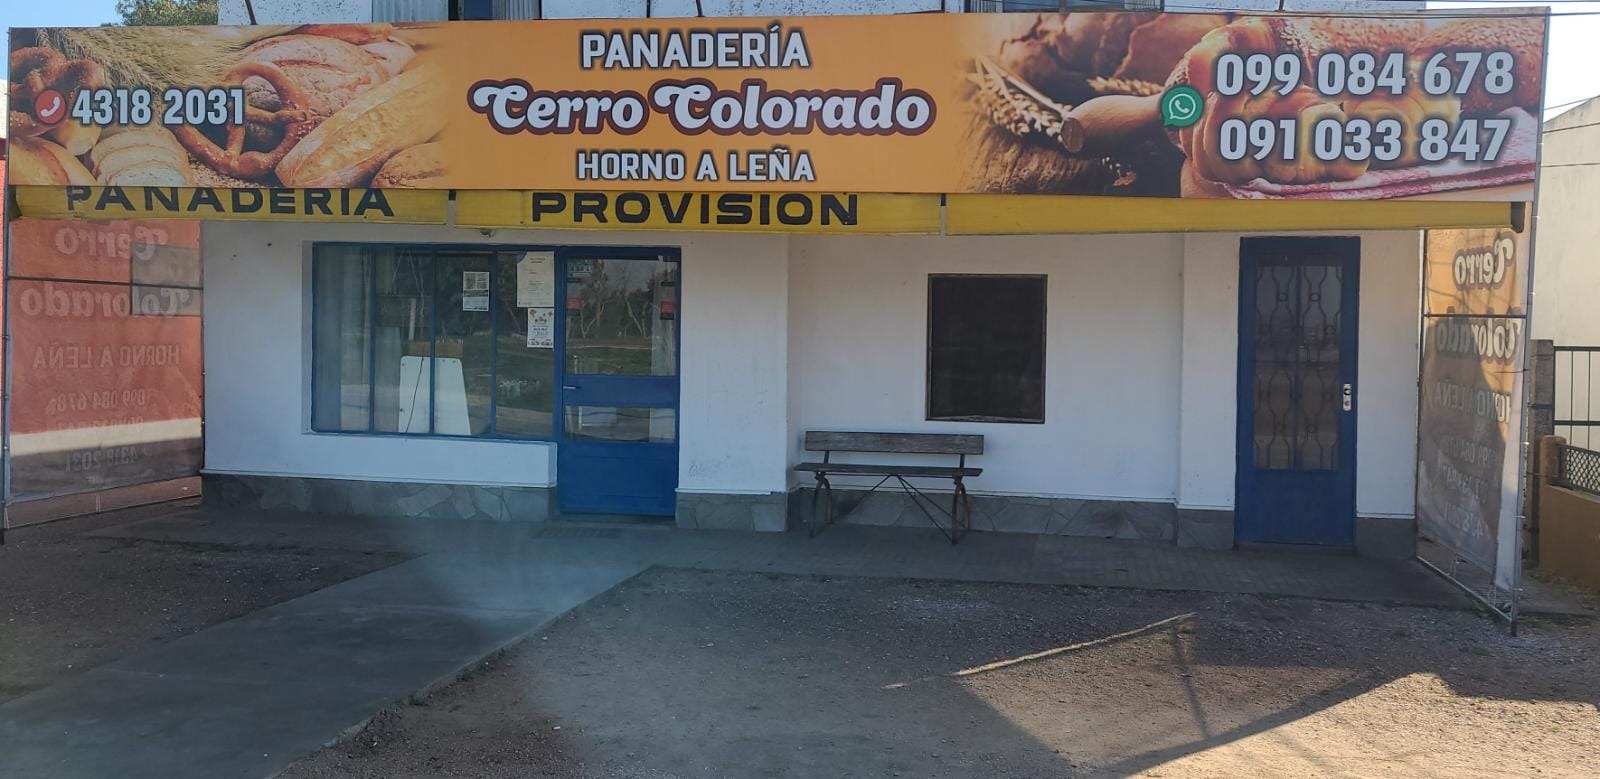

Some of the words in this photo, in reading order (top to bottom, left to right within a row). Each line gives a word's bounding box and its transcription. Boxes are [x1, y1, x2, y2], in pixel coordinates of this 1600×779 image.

[581, 24, 810, 69] PANADERÍA
[1216, 53, 1301, 97] 099
[1317, 52, 1406, 96] 084
[1423, 51, 1515, 95] 678
[72, 88, 152, 125] 4318
[163, 88, 245, 125] 2031
[470, 82, 646, 131] Cerro
[652, 80, 932, 131] Colorado
[1219, 118, 1297, 161] 091
[1314, 118, 1402, 161] 033
[1419, 118, 1511, 161] 847
[577, 151, 686, 181] HORNO
[696, 152, 719, 182] A
[728, 147, 815, 182] LEÑA
[532, 192, 858, 226] PROVISION
